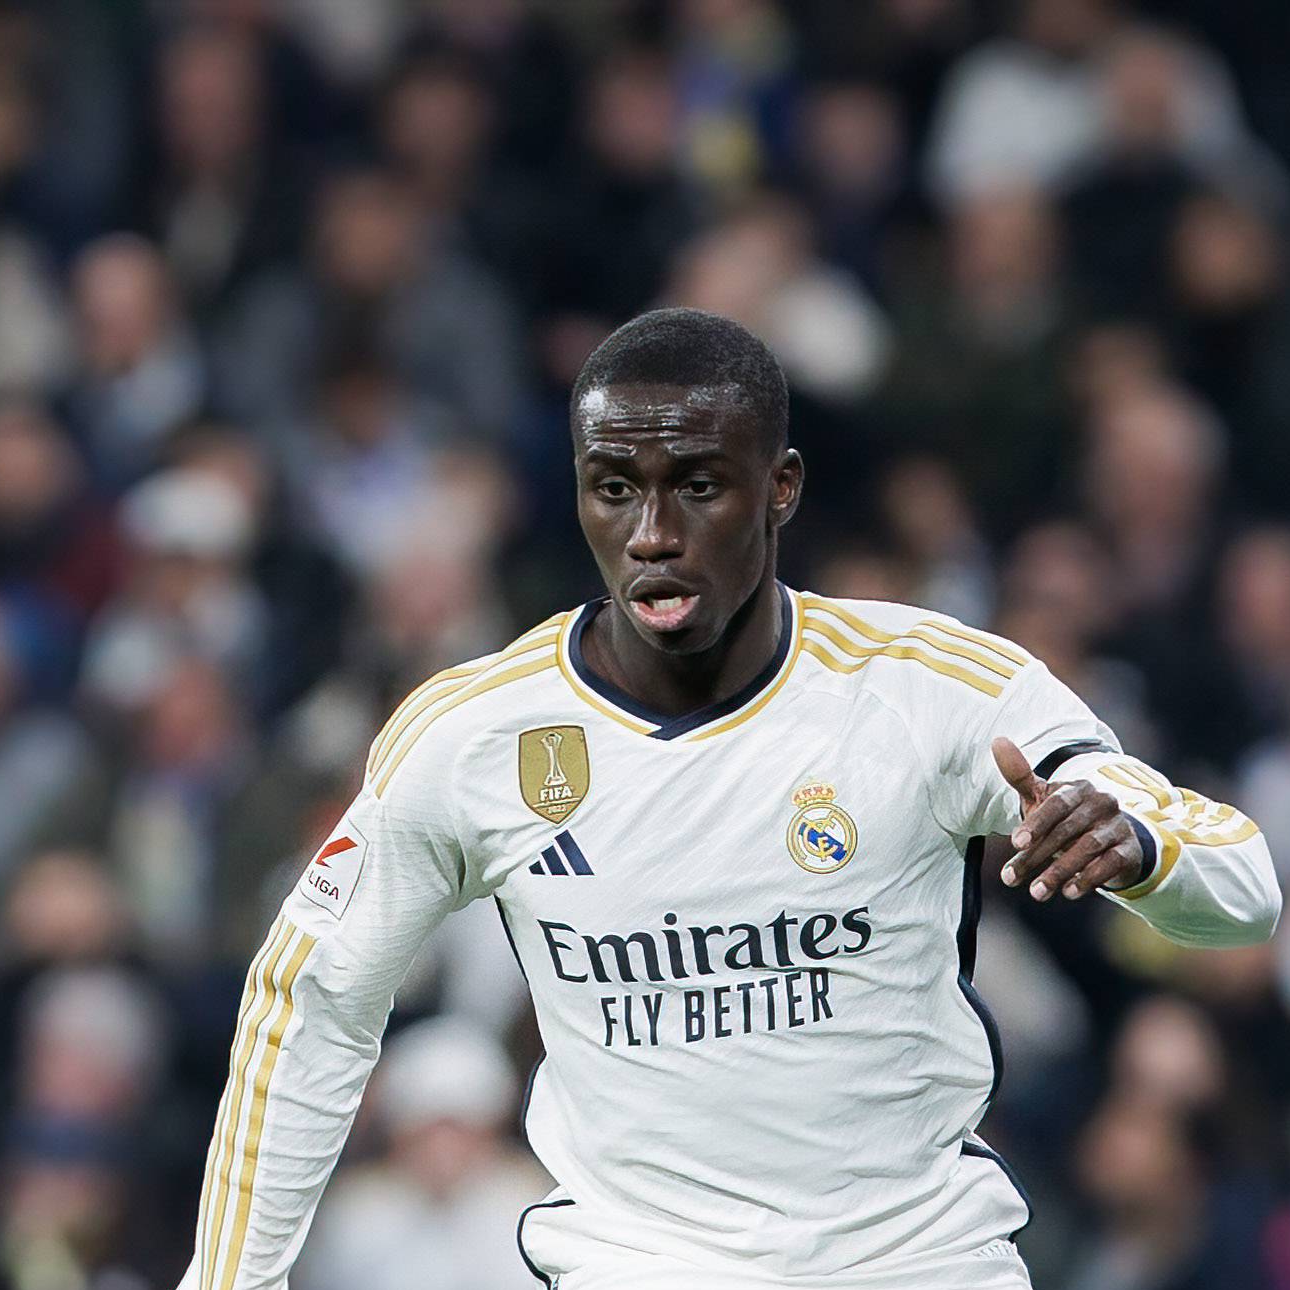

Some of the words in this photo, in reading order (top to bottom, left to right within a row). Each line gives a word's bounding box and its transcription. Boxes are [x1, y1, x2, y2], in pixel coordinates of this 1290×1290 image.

[540, 785, 573, 801] FIFA
[536, 906, 873, 984] Emirates
[600, 992, 663, 1046] FLY
[684, 967, 834, 1043] BETTER
